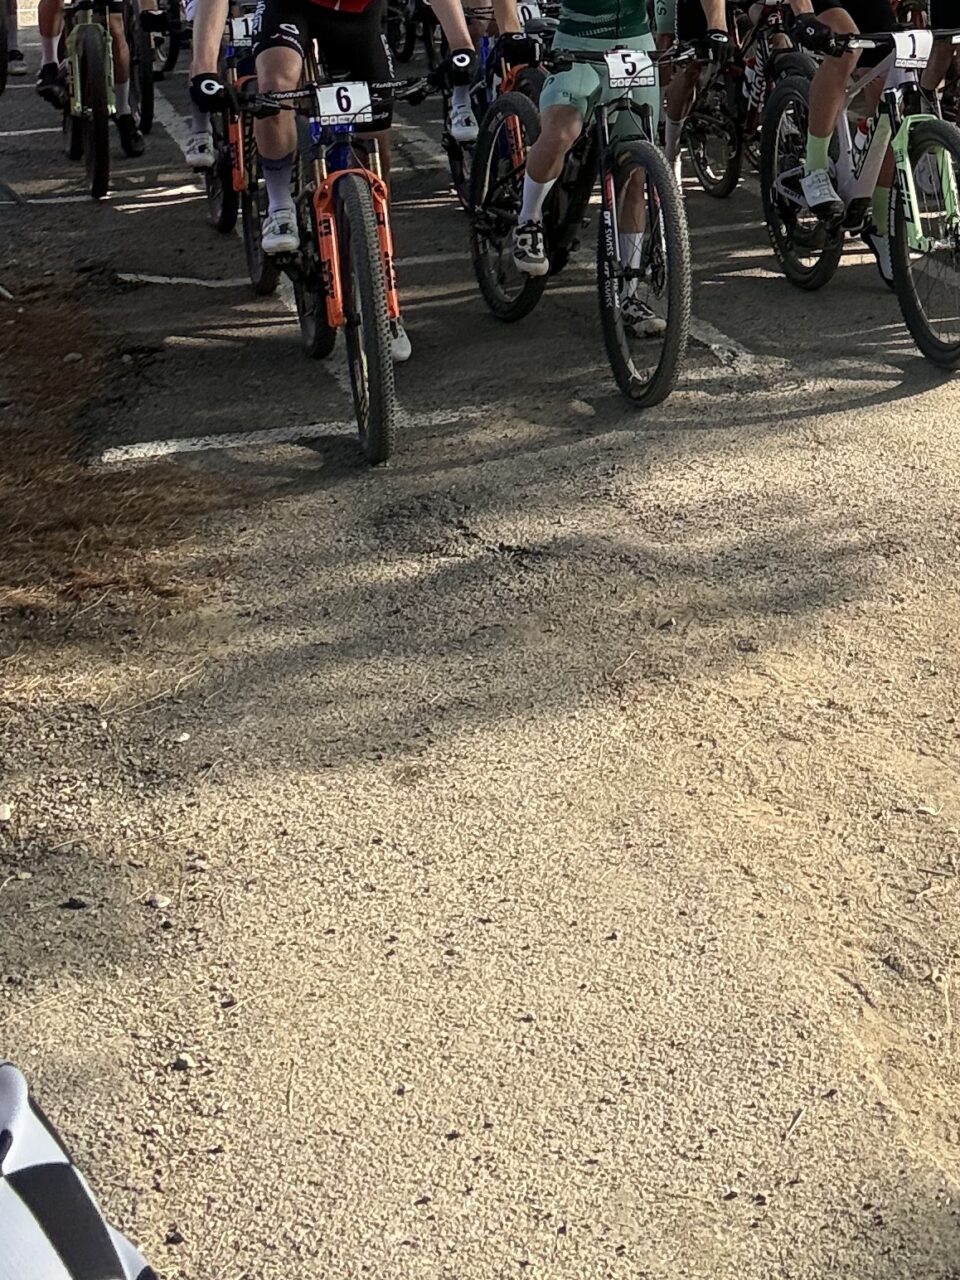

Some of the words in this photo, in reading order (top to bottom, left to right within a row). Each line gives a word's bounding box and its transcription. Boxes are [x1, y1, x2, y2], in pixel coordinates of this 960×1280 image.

[906, 32, 919, 58] 1
[621, 53, 638, 76] 5
[335, 86, 352, 113] 6
